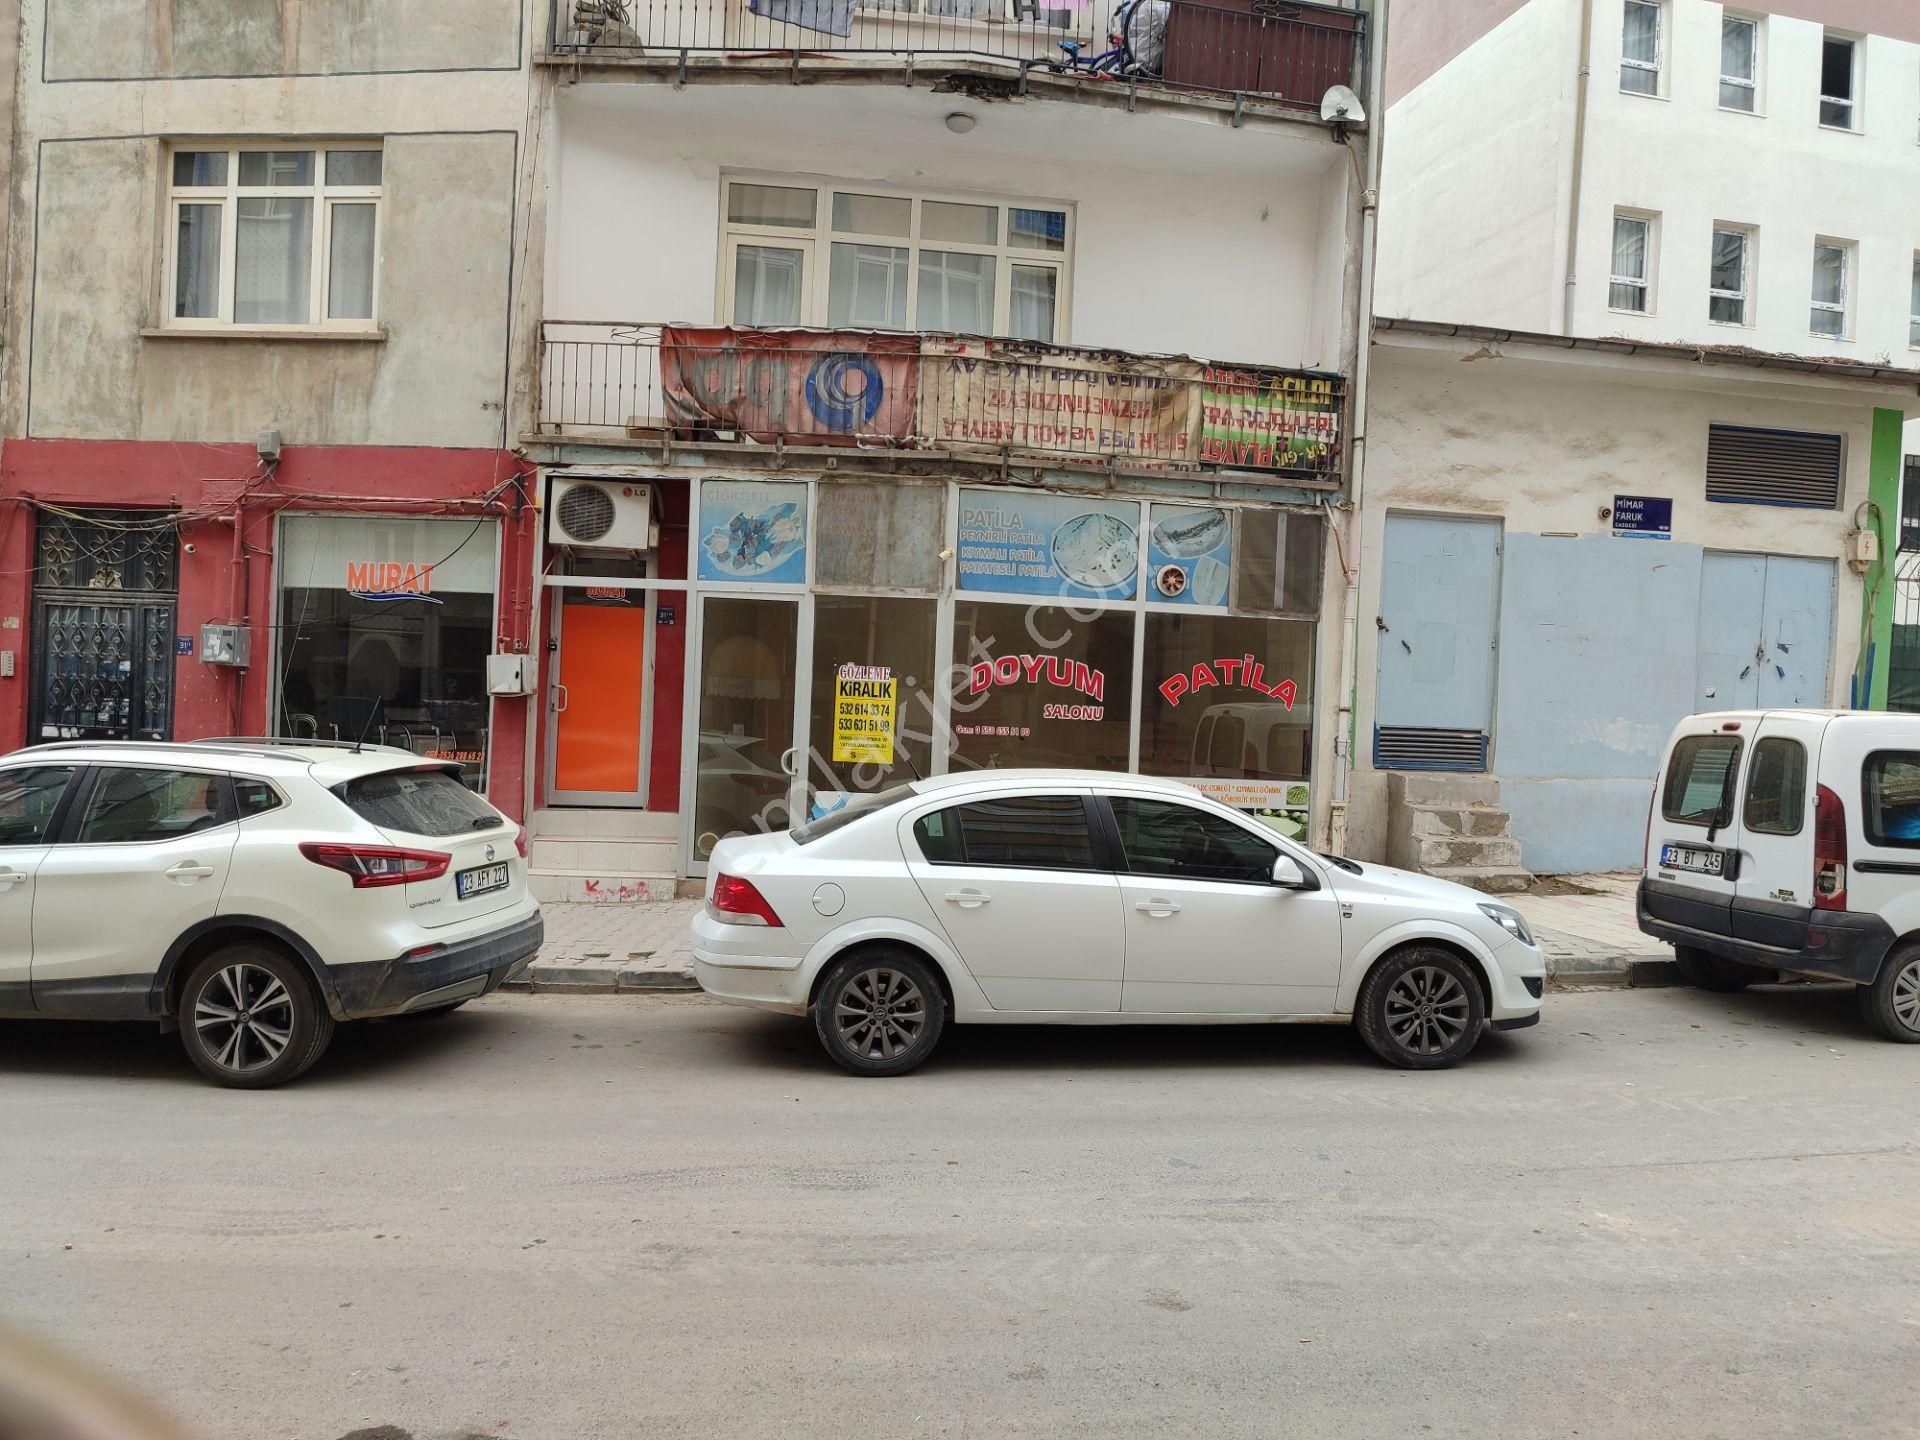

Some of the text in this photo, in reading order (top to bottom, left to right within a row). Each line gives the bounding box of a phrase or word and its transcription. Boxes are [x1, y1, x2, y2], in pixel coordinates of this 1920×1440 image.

[634, 489, 647, 497] LG
[1616, 498, 1645, 510] MİMAR
[962, 505, 1024, 530] PATİLA
[1615, 511, 1644, 522] FARUK
[1009, 530, 1047, 545] PATİLA
[961, 546, 1046, 562] KIYMALI PATİLA
[347, 561, 434, 594] MURAT
[839, 662, 891, 682] GÖZLEME
[970, 654, 1105, 702] DOYUM
[1158, 653, 1298, 712] PATİLA
[840, 703, 853, 715] 532
[855, 703, 868, 716] 614
[881, 704, 890, 717] 74
[1044, 704, 1104, 721] SALONU
[839, 718, 852, 731] 533
[854, 719, 867, 732] 631
[1667, 849, 1721, 869] 23 BT 245
[464, 865, 506, 891] 23 AFY 227
